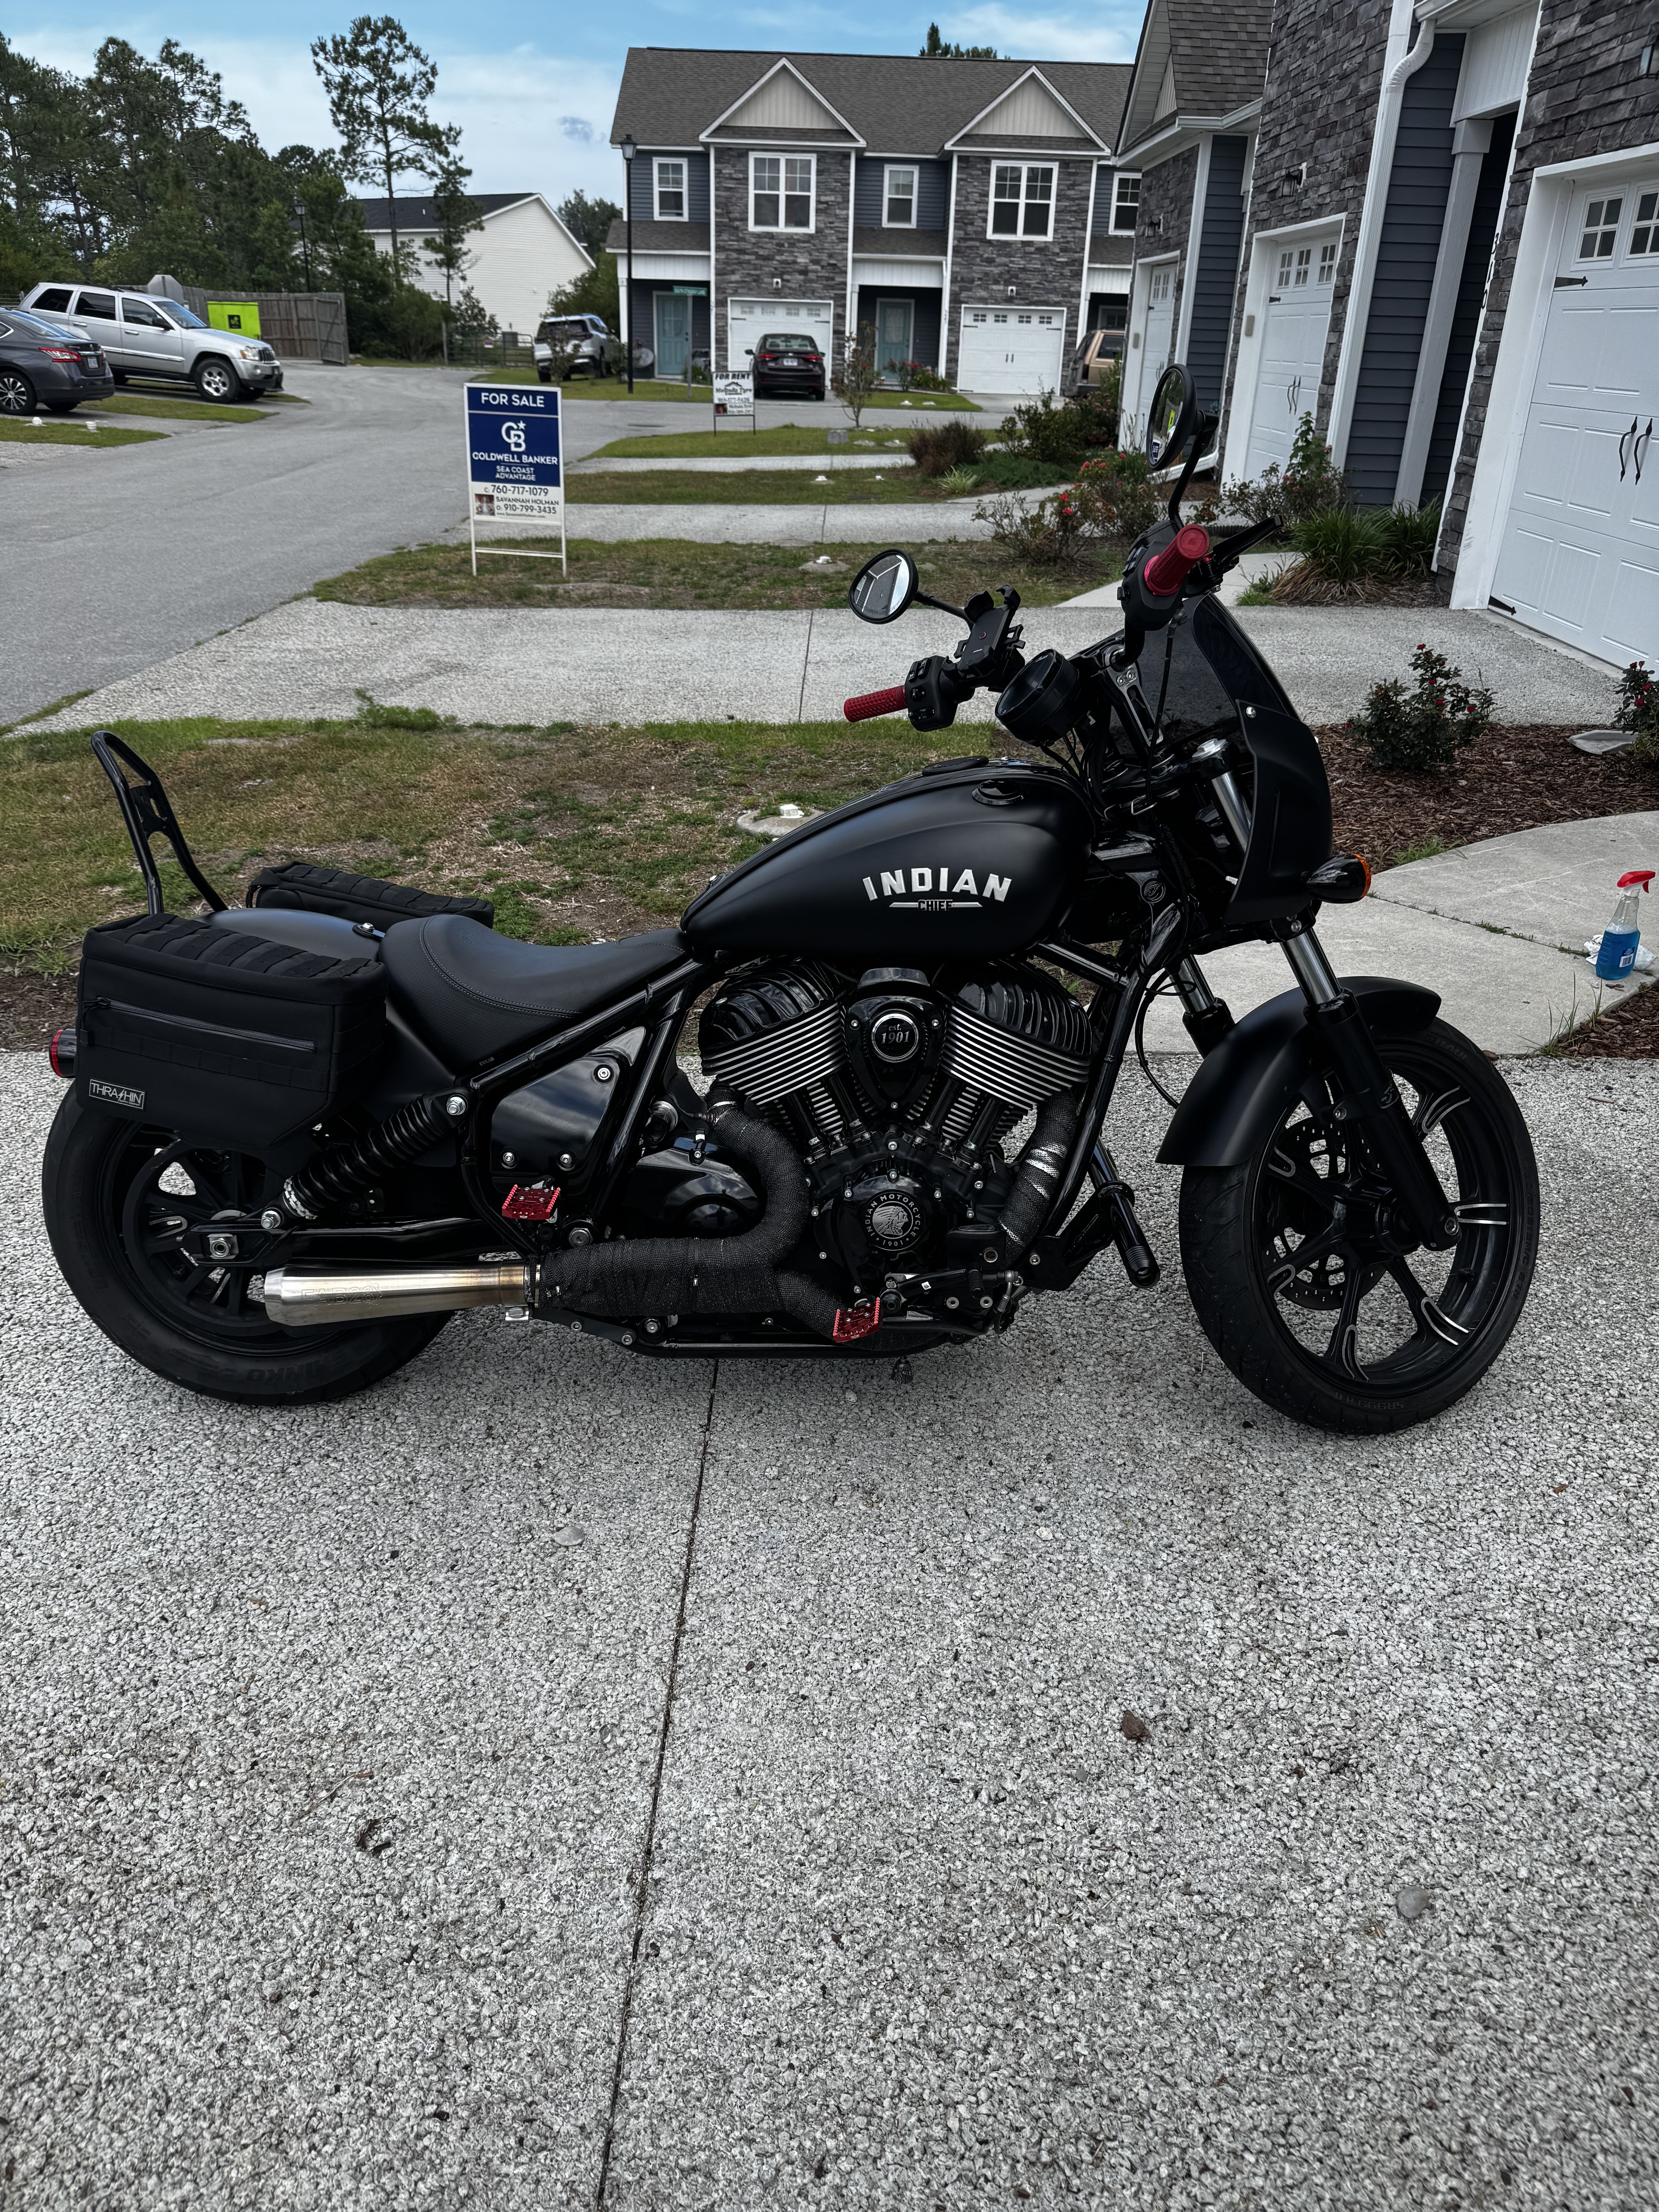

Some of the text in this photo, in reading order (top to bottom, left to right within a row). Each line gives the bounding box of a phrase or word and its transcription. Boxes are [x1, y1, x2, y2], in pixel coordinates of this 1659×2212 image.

[481, 393, 545, 408] FOR SALE
[472, 452, 558, 465] COLDWELL BANKER
[491, 485, 548, 496] 760-717-1079
[504, 503, 556, 514] 910-799-3435
[862, 867, 1012, 902] INDIAN
[918, 900, 953, 911] CHIEF
[880, 1031, 910, 1044] 1901
[865, 1194, 921, 1237] INDIAN MOTORCYCLE
[301, 1286, 374, 1307] FAB28
